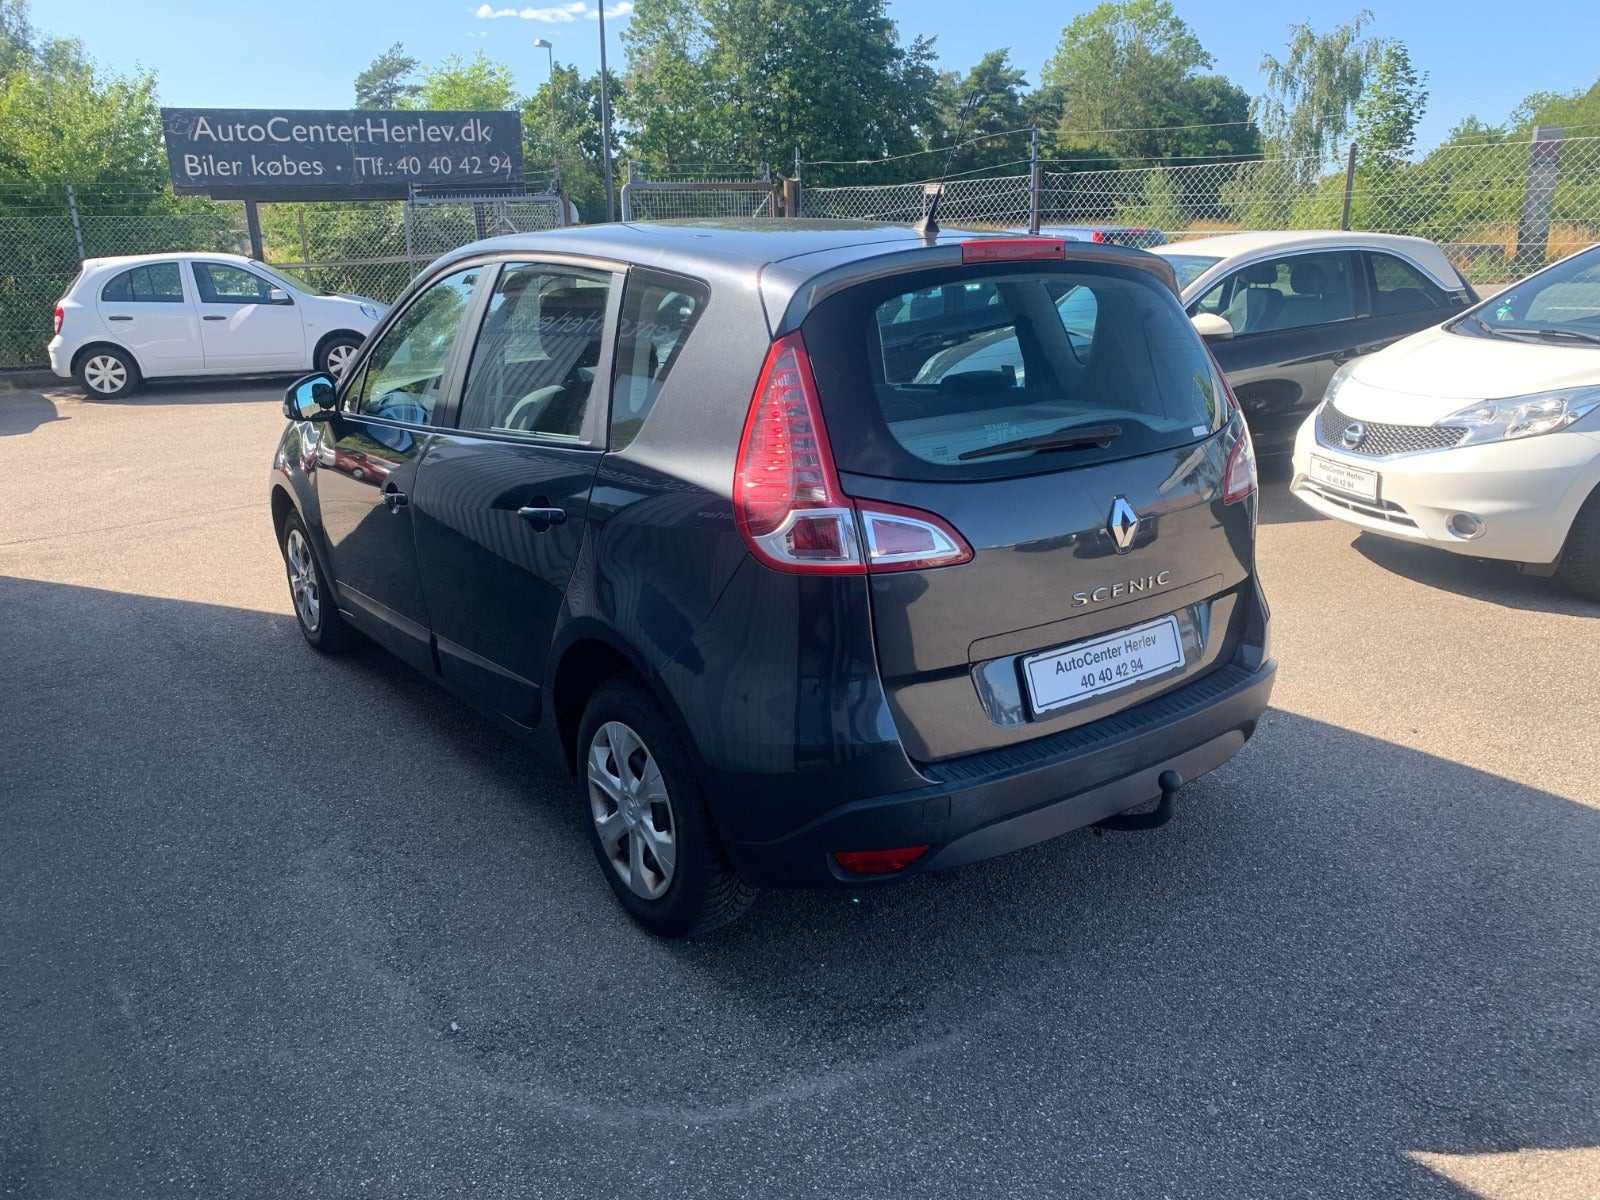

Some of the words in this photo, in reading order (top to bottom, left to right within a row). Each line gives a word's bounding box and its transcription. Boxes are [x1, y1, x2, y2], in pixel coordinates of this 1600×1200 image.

[193, 117, 492, 143] AutoCenterHerlev.dk
[184, 154, 241, 177] Biler
[252, 154, 324, 176] købes
[428, 156, 452, 175] 40
[459, 156, 483, 174] 42
[489, 155, 513, 174] 94
[1055, 644, 1122, 675] AutoCenter
[1124, 633, 1157, 655] Herlev
[1080, 673, 1096, 689] 40
[1098, 668, 1113, 684] 40
[1115, 663, 1129, 678] 42
[1130, 657, 1144, 673] 94
